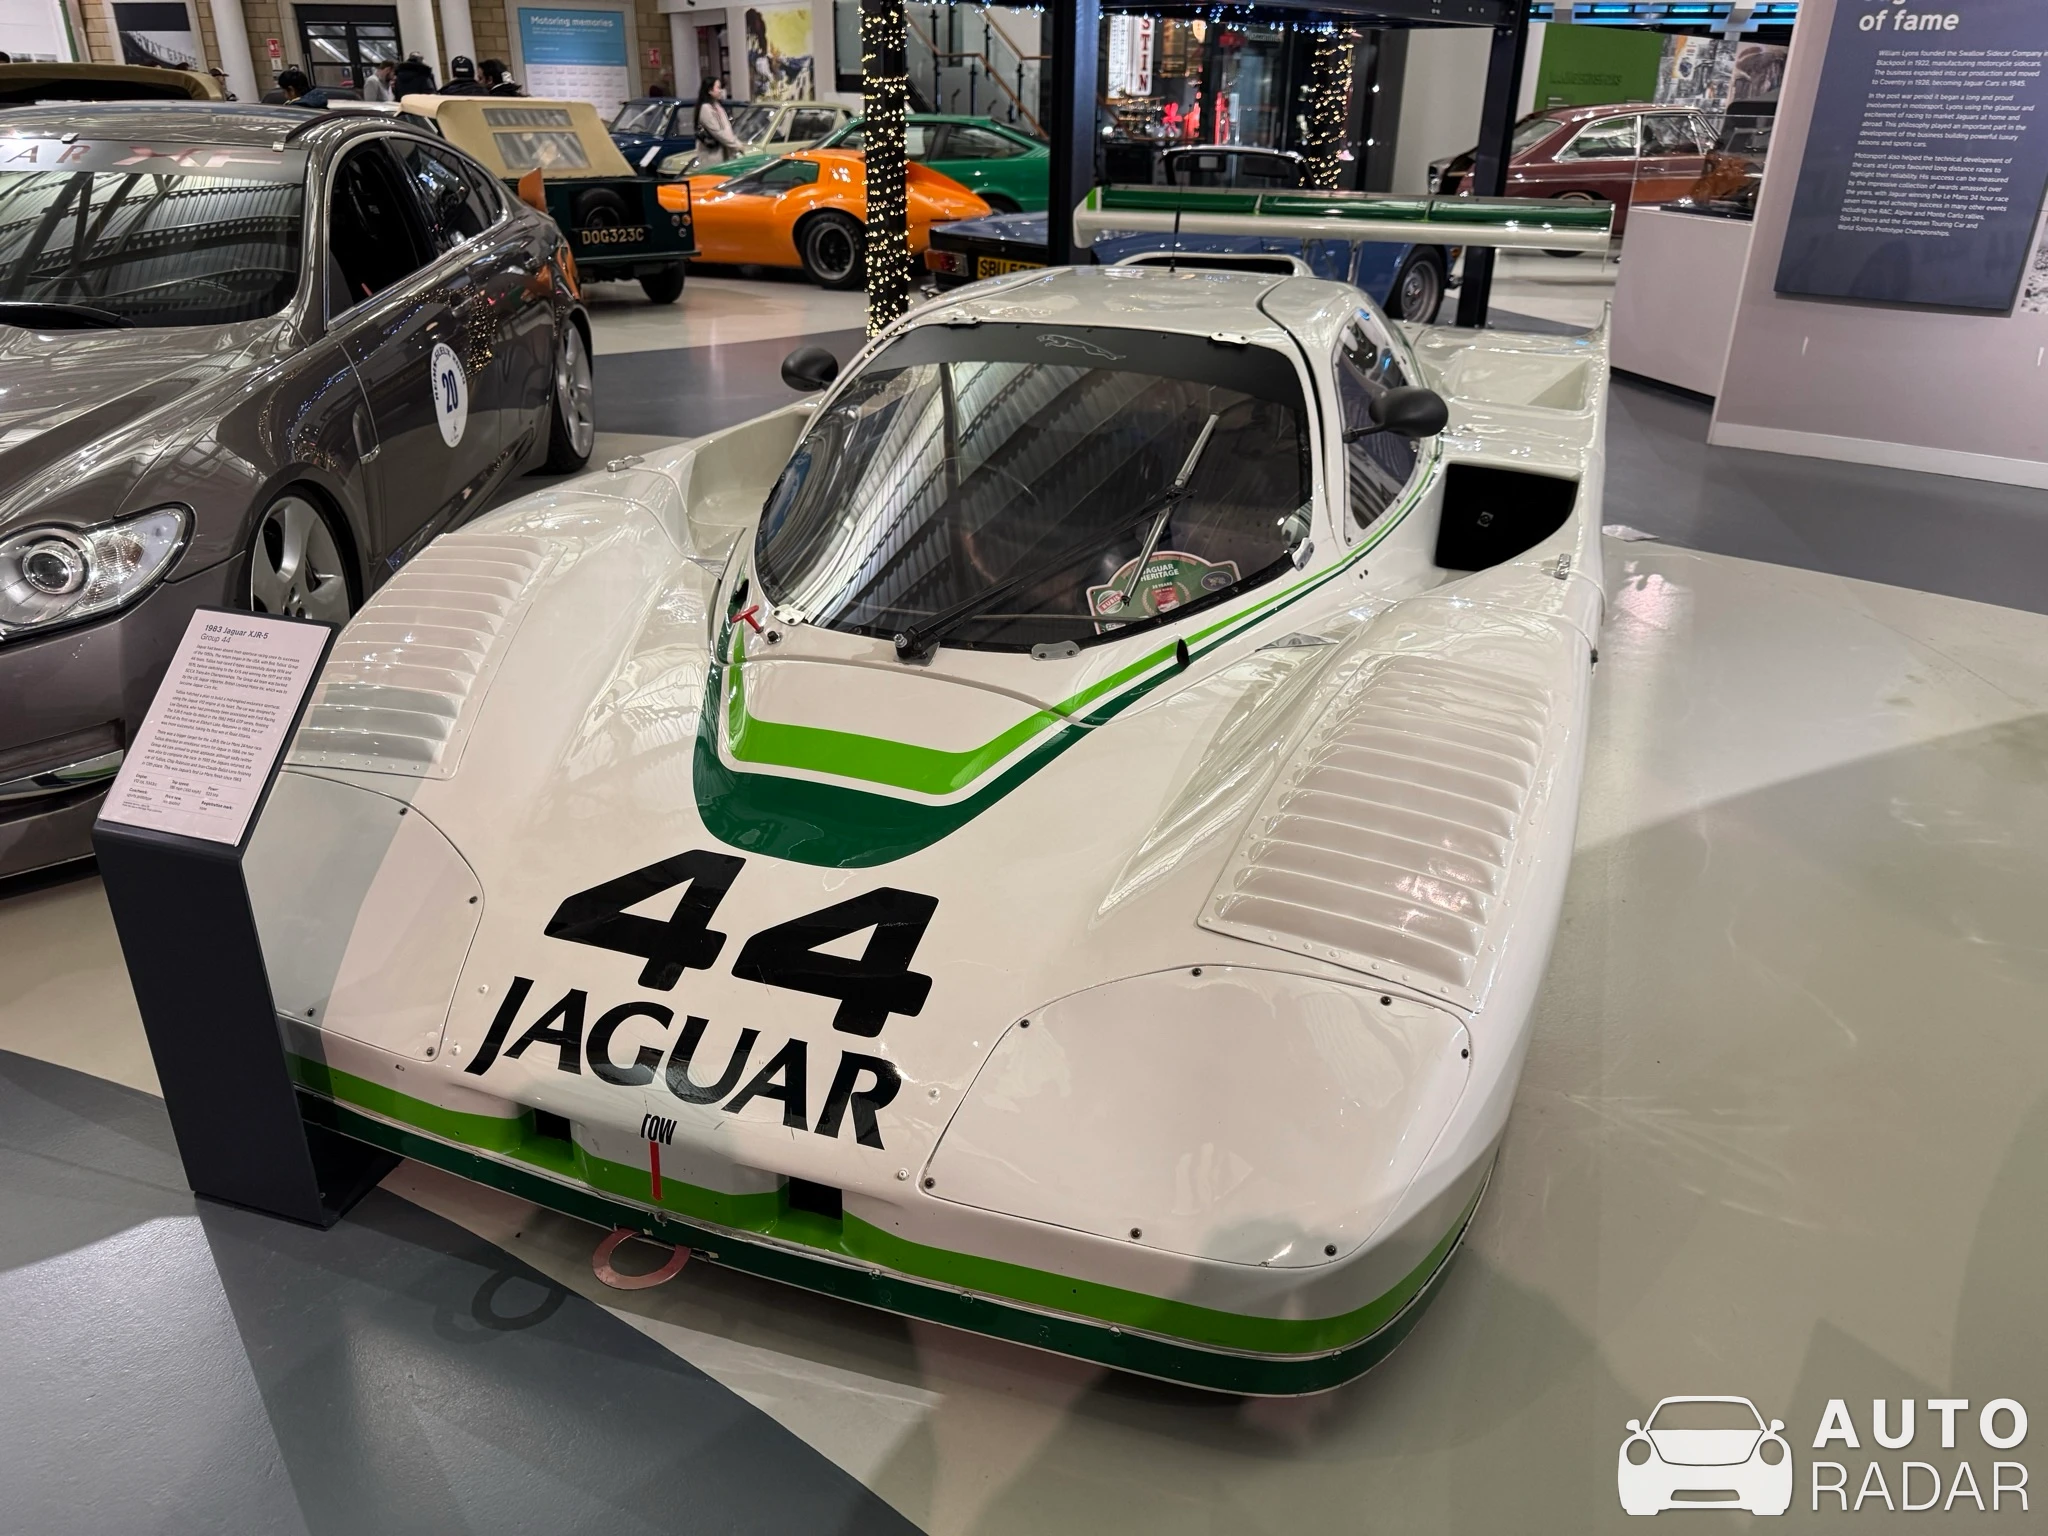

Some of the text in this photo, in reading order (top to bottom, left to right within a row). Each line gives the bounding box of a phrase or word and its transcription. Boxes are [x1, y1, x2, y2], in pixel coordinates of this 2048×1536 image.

[531, 16, 614, 27] Motoring memories
[1859, 10, 1959, 30] of fame
[582, 228, 644, 245] DOG323C
[442, 370, 458, 414] 20
[200, 633, 220, 643] Group
[205, 624, 269, 639] 1983 Jaguar XJR-5
[543, 849, 939, 1038] 44
[464, 976, 902, 1151] JAGUAR
